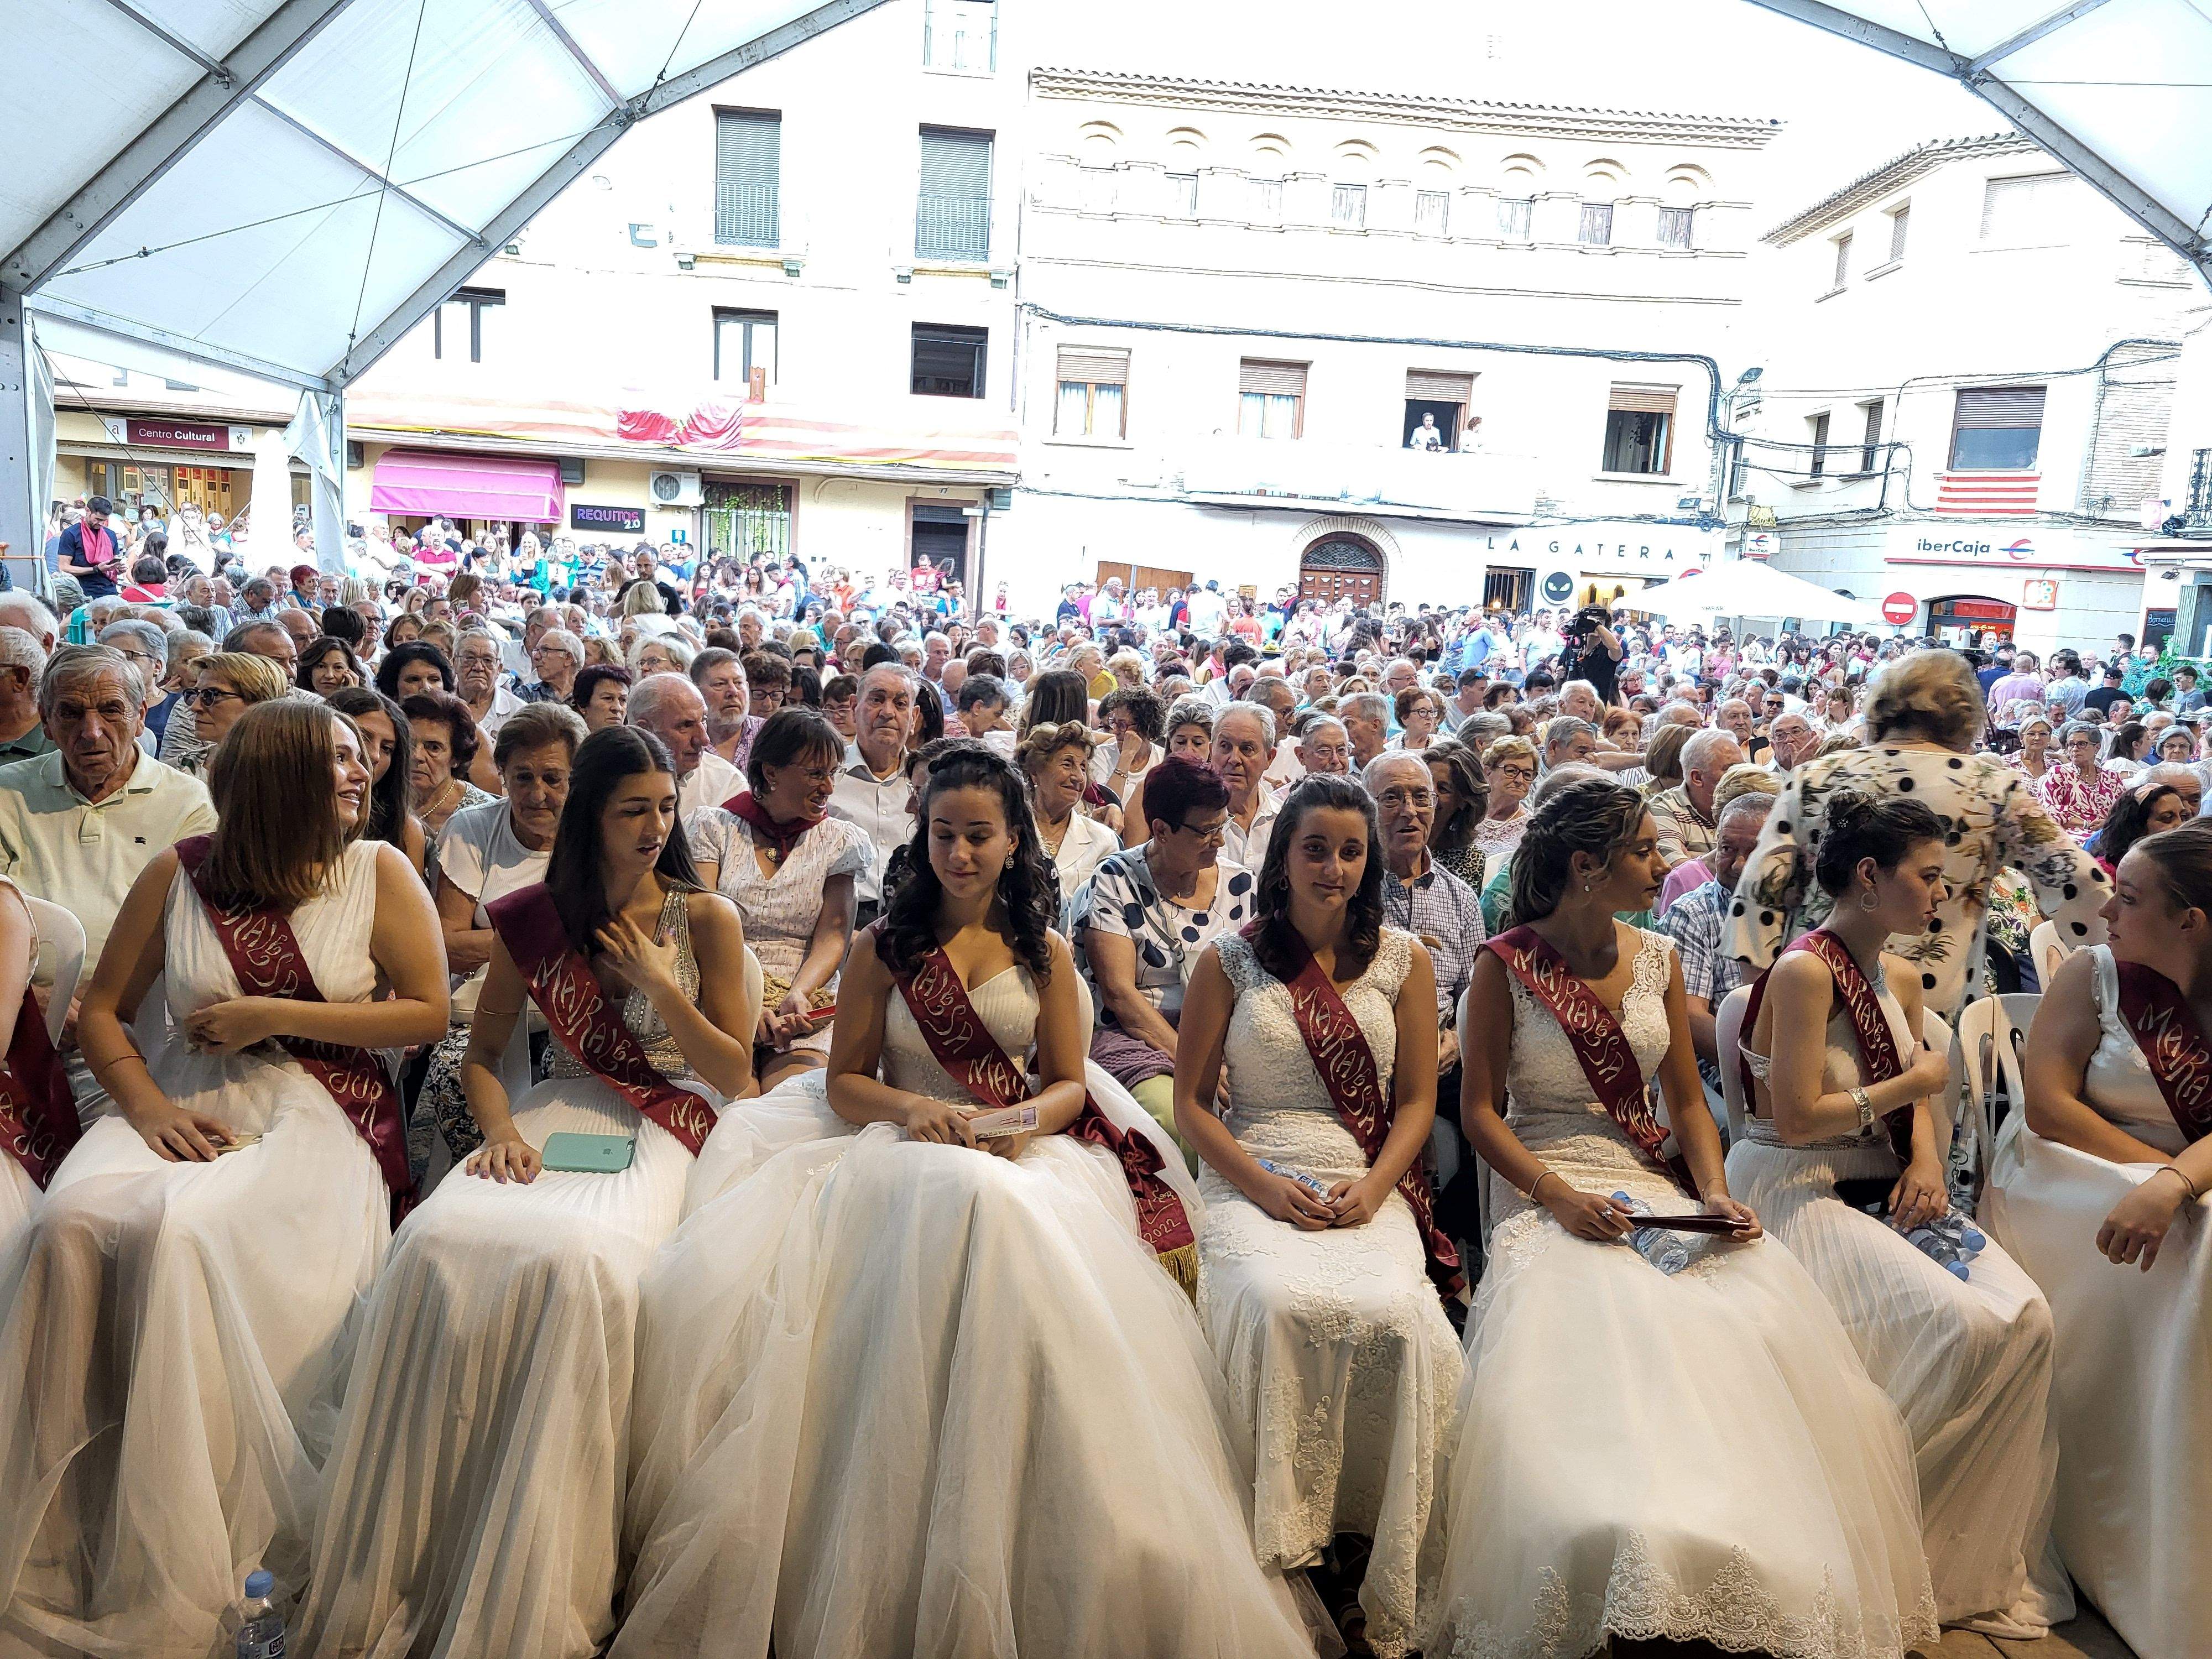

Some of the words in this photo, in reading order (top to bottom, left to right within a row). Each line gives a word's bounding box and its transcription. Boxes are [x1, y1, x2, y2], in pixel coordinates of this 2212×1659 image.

[139, 428, 172, 439] Centro
[174, 430, 215, 442] Cultural
[577, 508, 639, 522] REQUITOS
[624, 519, 641, 529] 2.0
[1488, 537, 1519, 551] LA
[1549, 541, 1673, 560] GATERA
[1917, 539, 1990, 556] iberCaja
[1143, 1218, 1181, 1244] 2022
